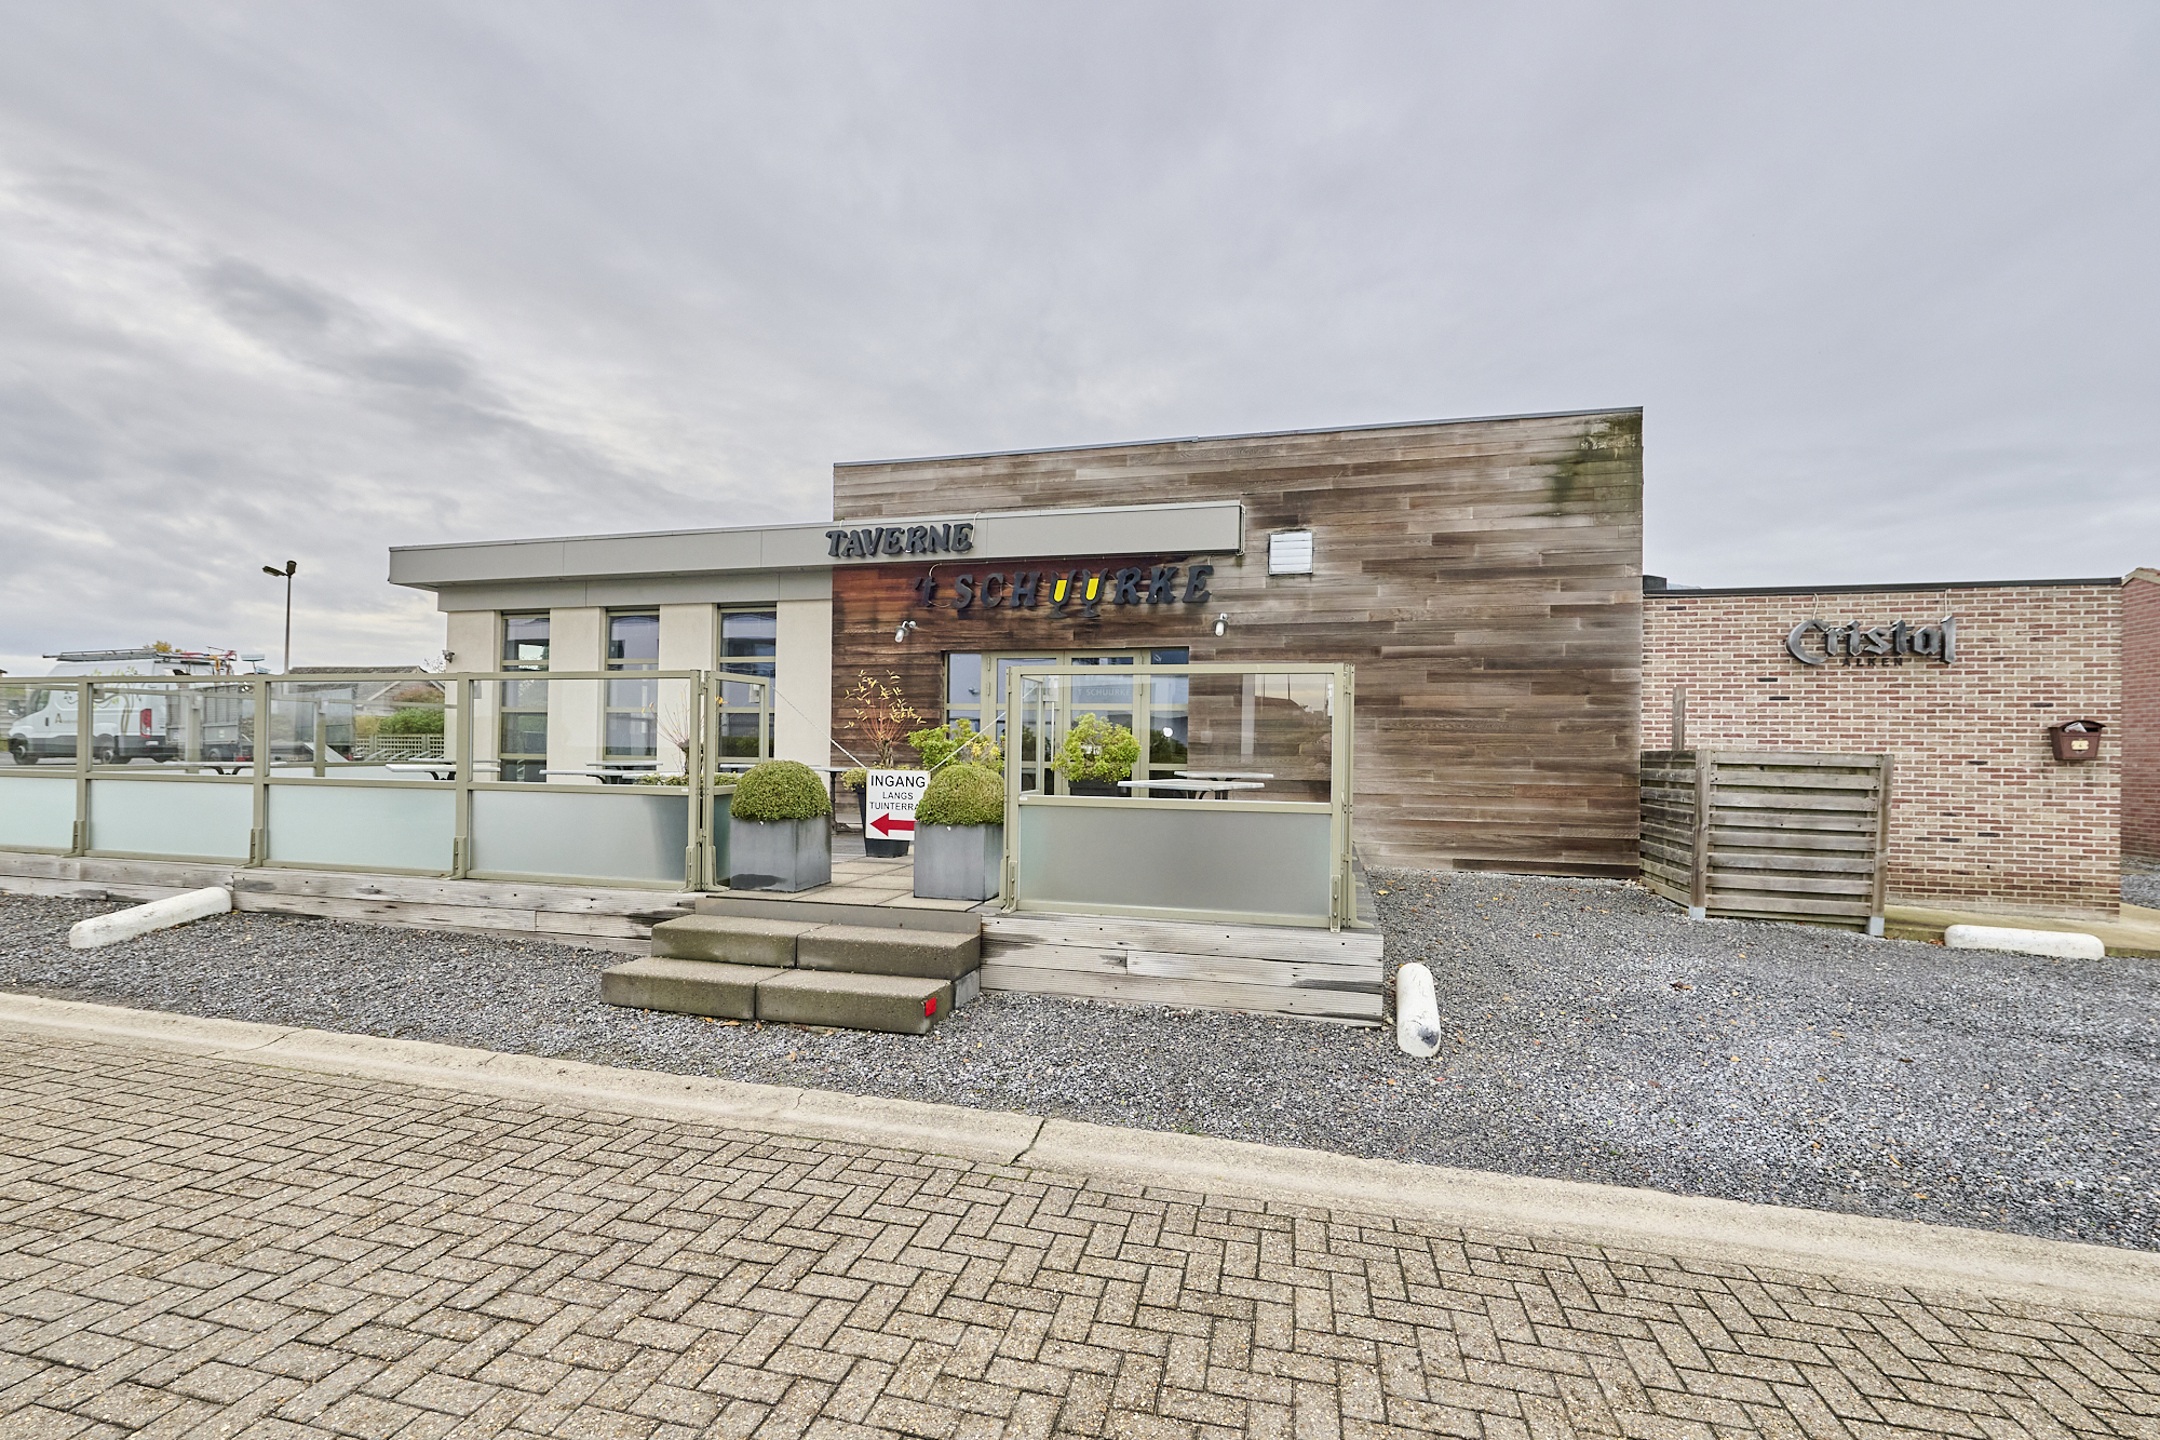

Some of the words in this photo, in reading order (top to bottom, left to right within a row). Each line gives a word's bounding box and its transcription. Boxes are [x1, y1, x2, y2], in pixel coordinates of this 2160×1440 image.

[825, 523, 973, 557] TAVERNE
[953, 565, 1214, 619] SCHUURKE
[1786, 616, 1956, 665] Cristal
[1842, 658, 1903, 666] ALKEN
[871, 775, 926, 788] INGANG
[882, 791, 914, 800] LANGS
